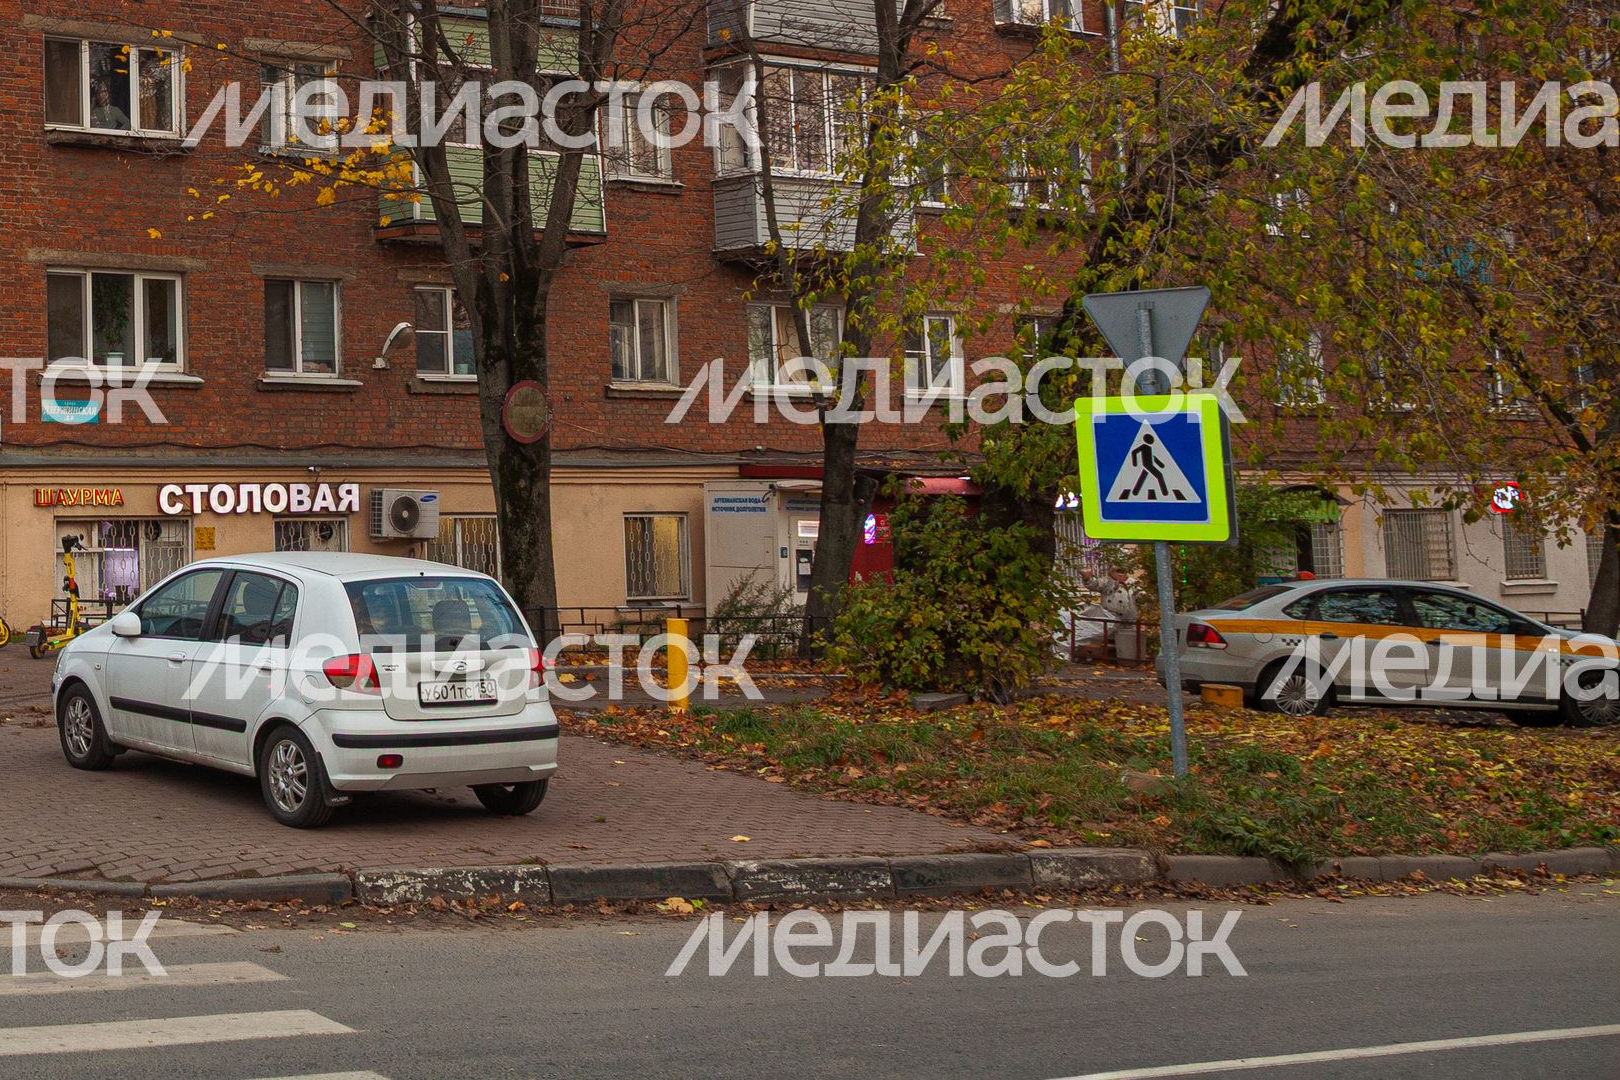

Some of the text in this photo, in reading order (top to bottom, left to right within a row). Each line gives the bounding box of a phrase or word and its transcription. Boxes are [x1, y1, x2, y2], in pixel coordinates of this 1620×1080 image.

[34, 487, 125, 507] ШАУРМА
[158, 483, 360, 515] СТОЛОВАЯ
[475, 681, 494, 694] 150
